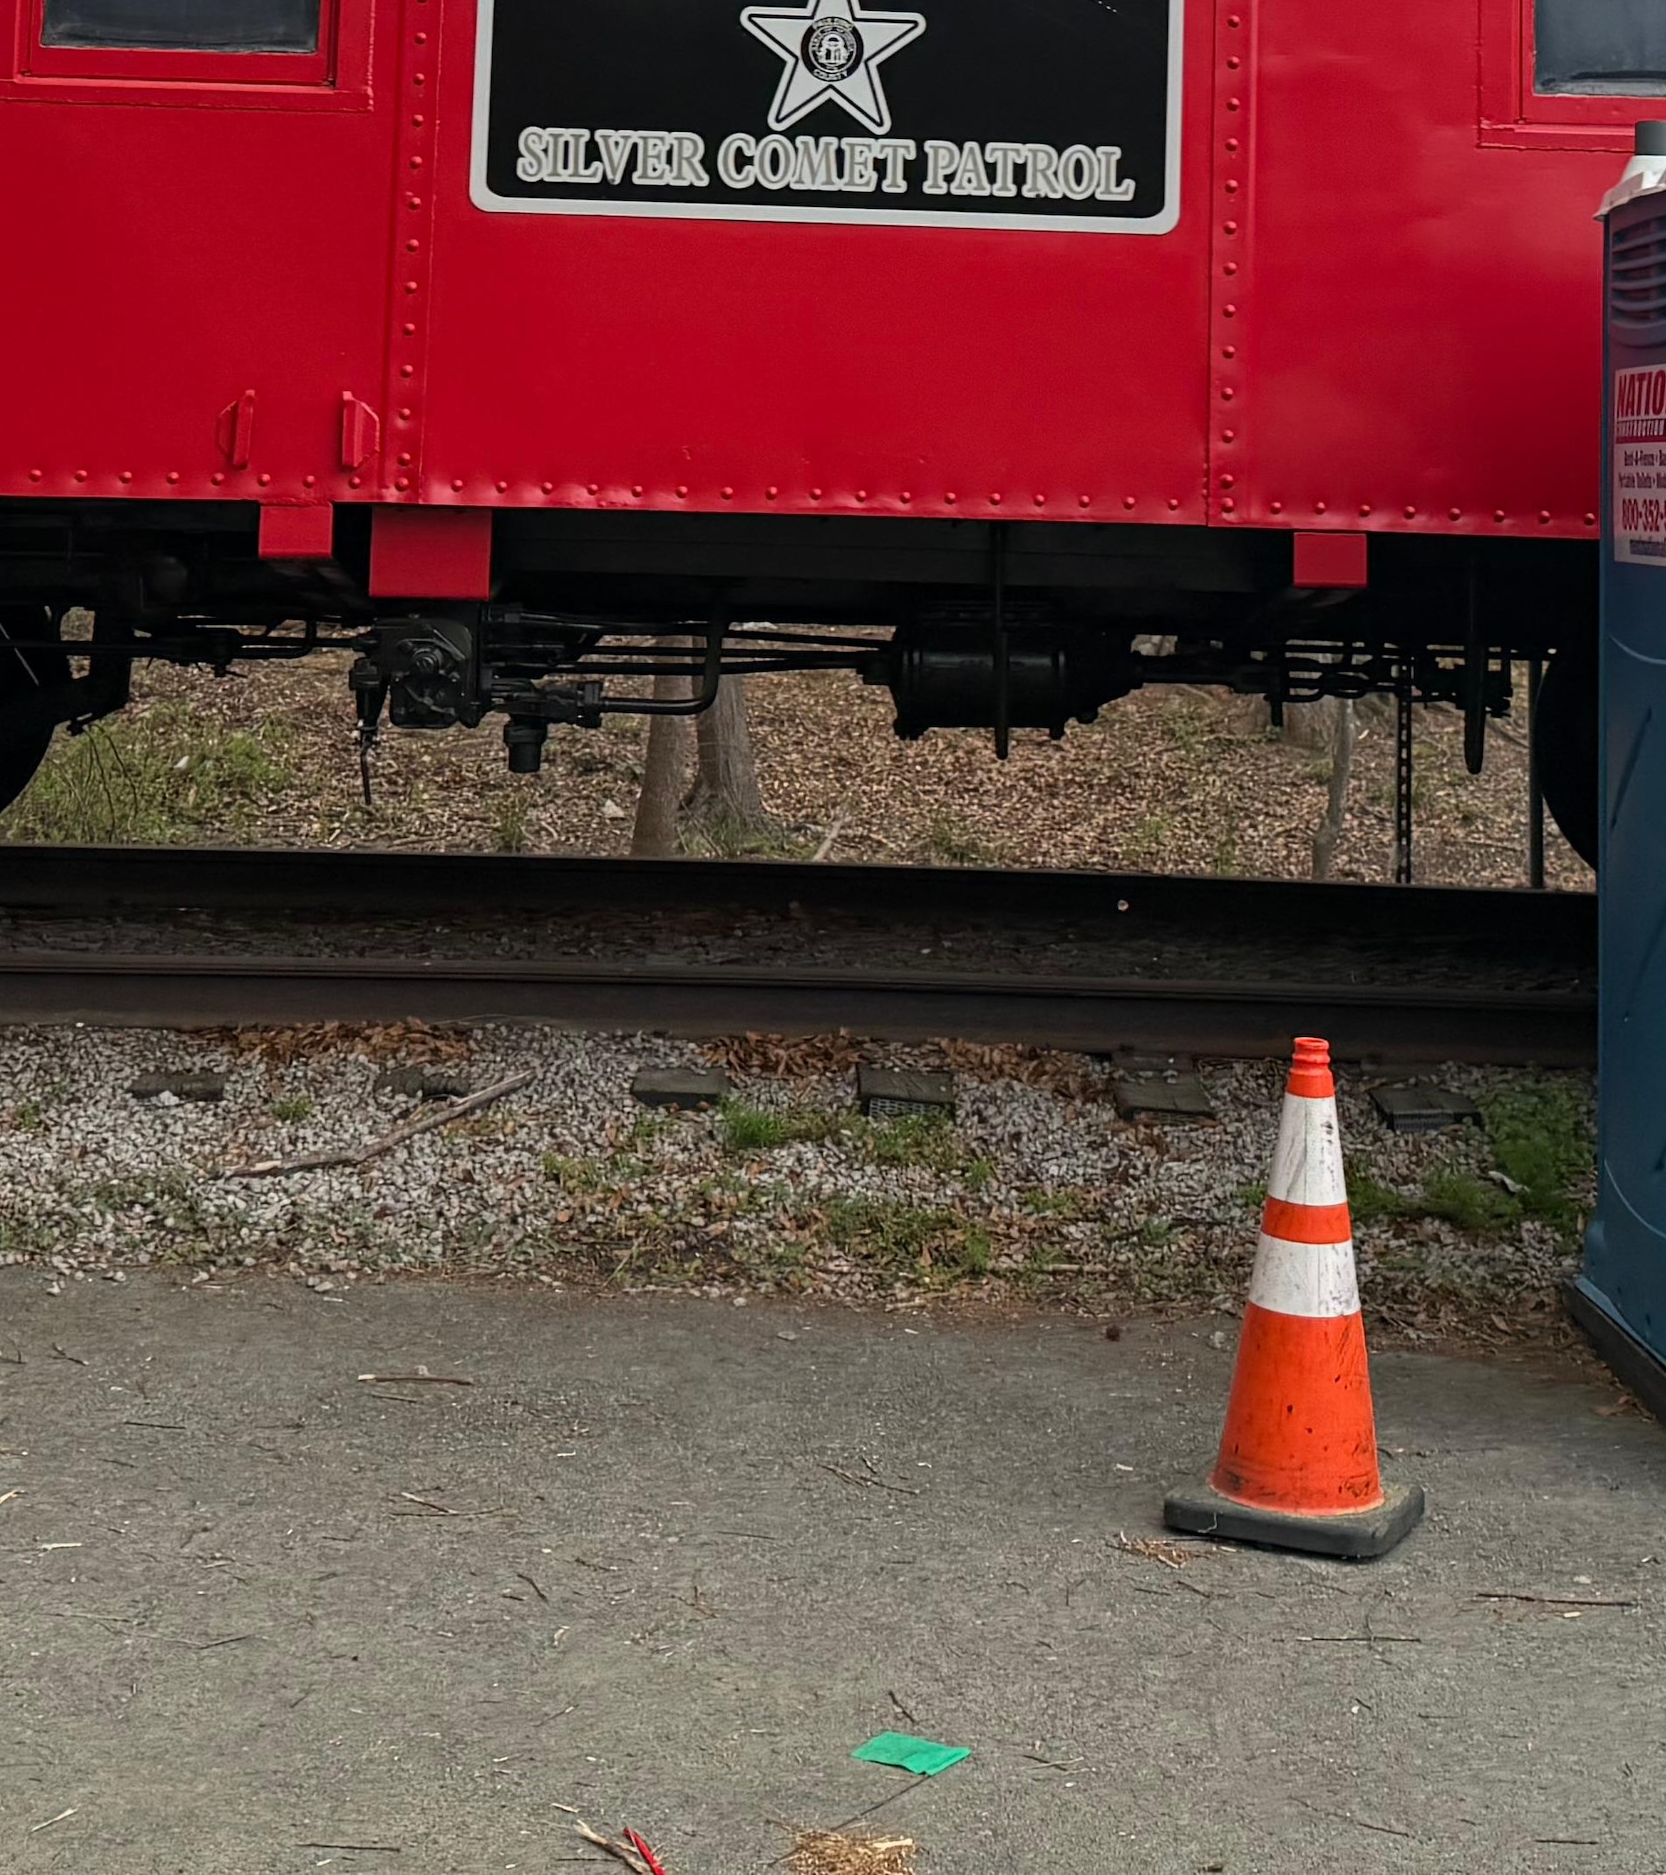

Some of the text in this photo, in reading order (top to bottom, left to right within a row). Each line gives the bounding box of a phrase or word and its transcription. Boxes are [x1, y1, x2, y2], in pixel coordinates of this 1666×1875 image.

[516, 126, 1135, 202] SILVER COMET PATROL
